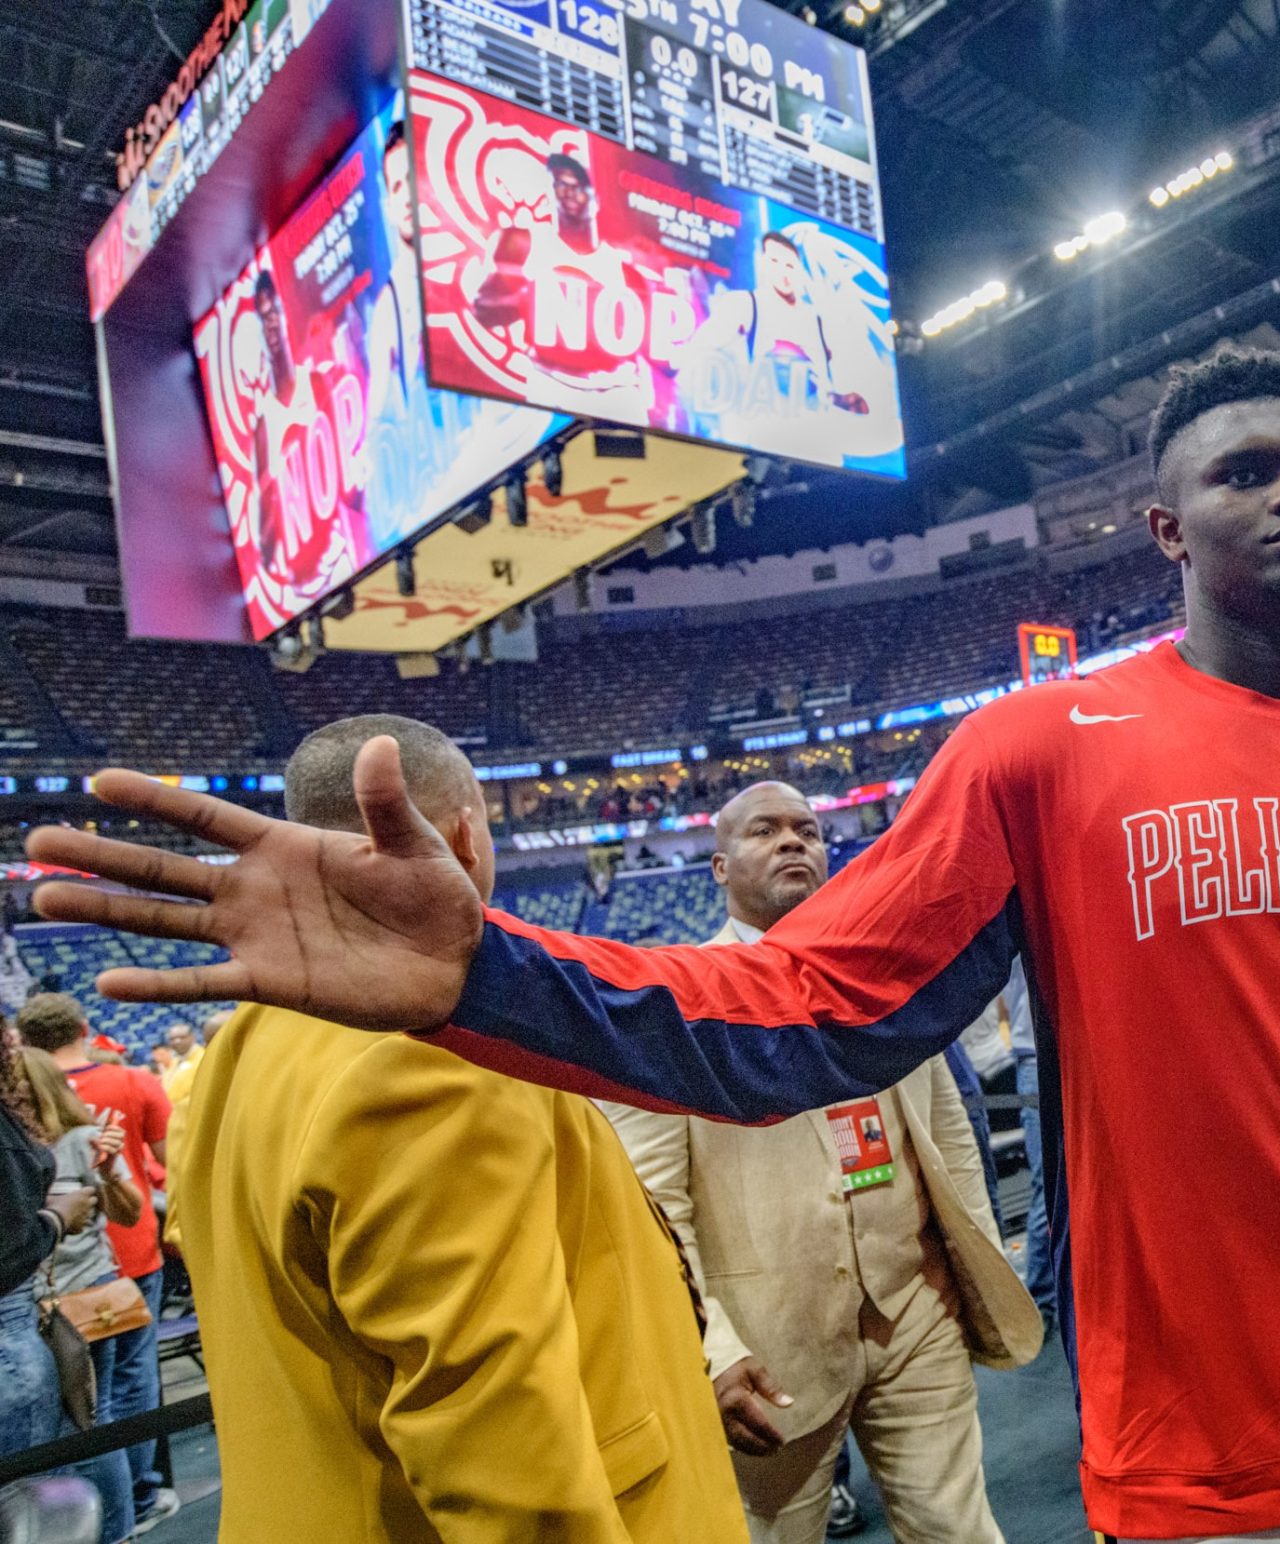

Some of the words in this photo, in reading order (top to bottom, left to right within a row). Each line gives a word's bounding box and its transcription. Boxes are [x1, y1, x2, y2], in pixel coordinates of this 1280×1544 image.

[560, 0, 620, 46] 128
[688, 12, 774, 78] 7:00
[783, 60, 825, 101] PM
[651, 36, 698, 78] 0.0
[722, 70, 770, 112] 127
[533, 272, 697, 364] NOP
[279, 374, 366, 560] NOP
